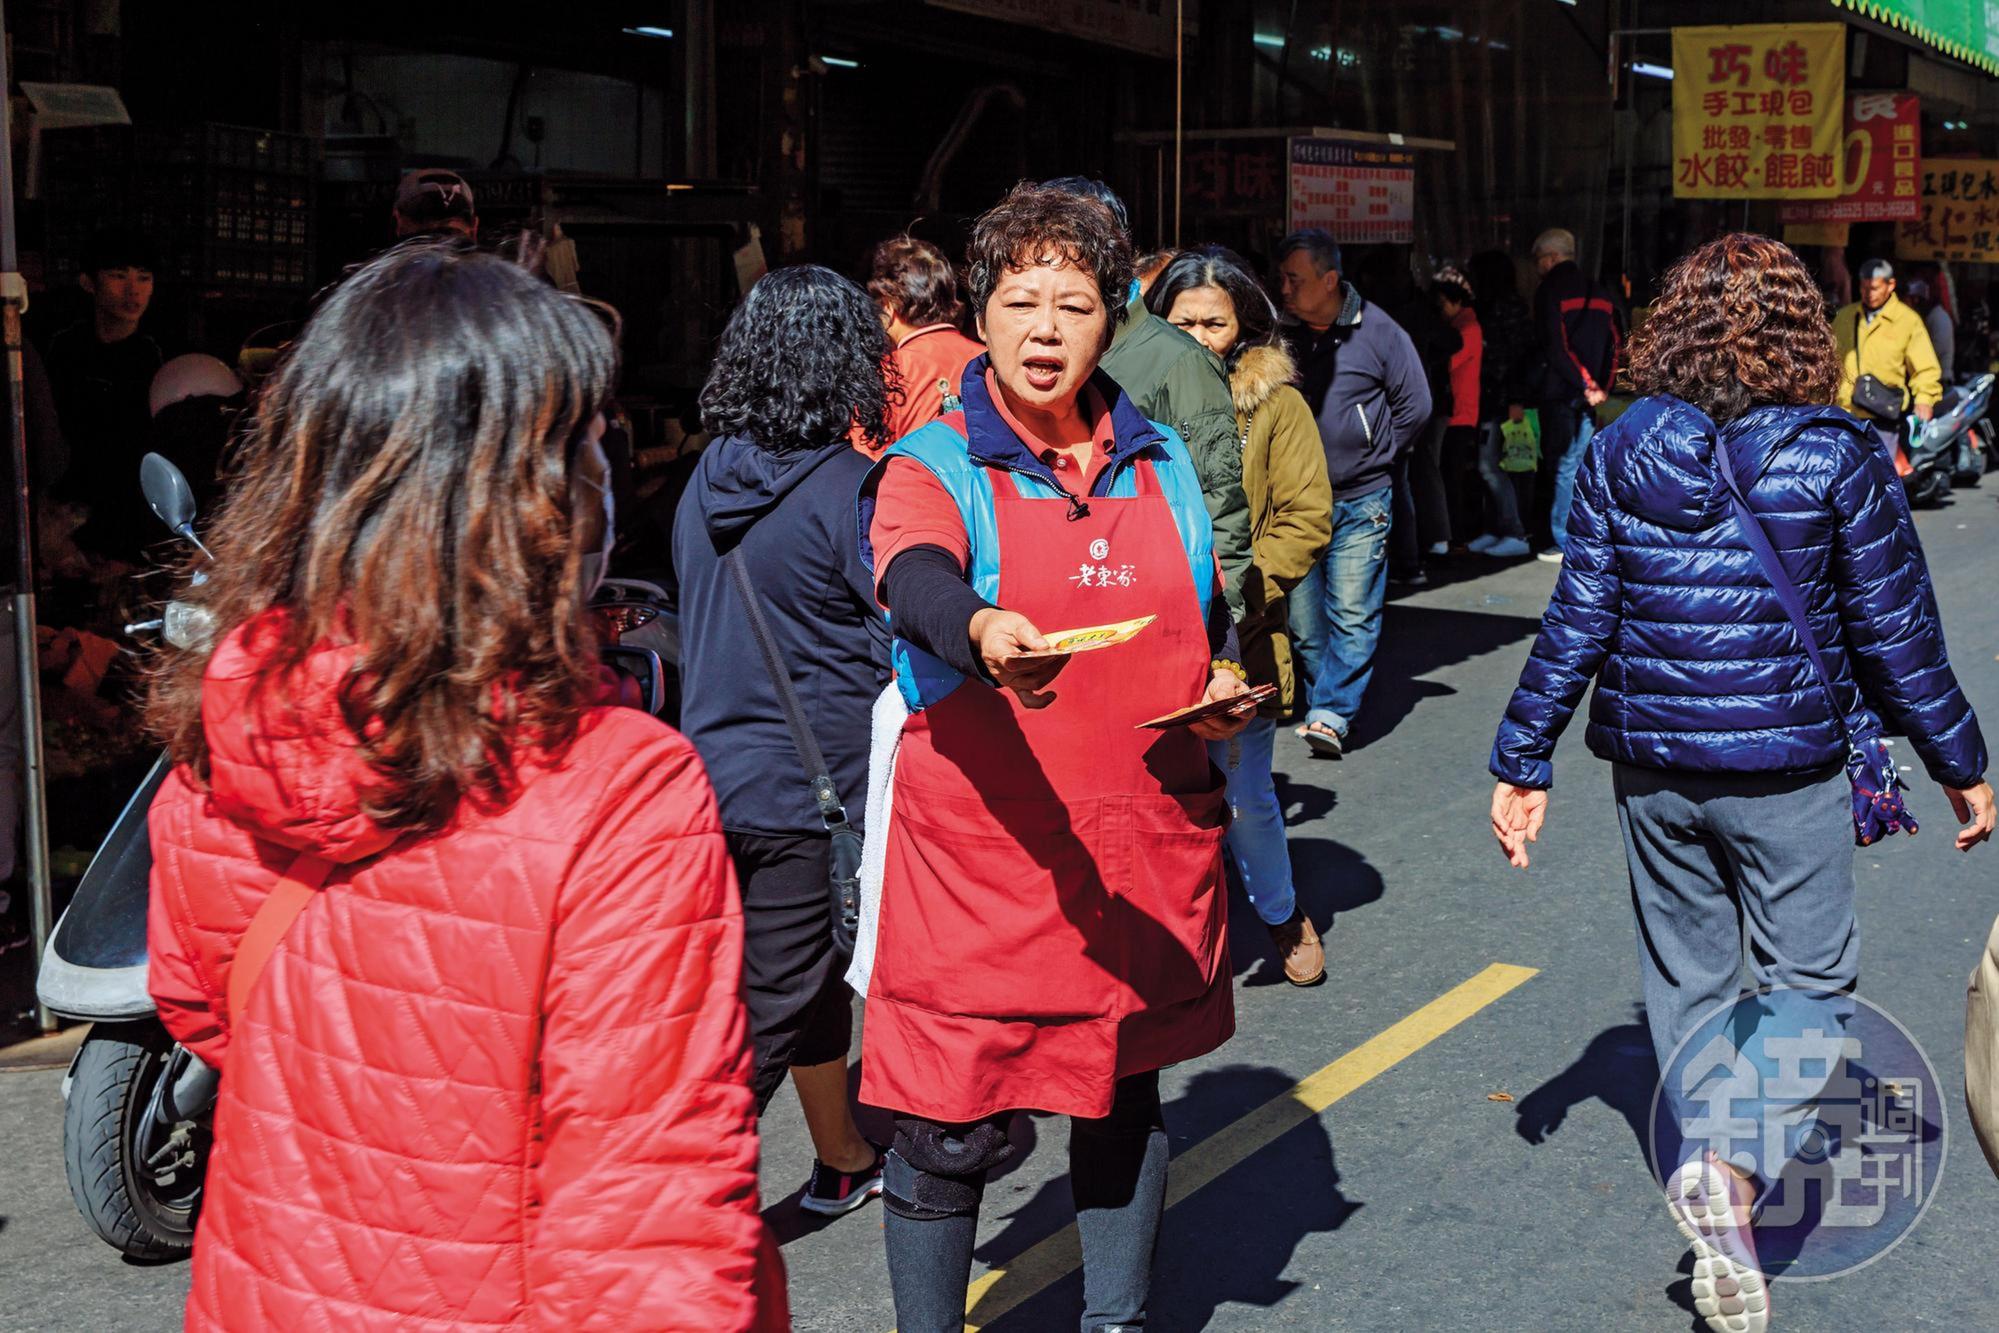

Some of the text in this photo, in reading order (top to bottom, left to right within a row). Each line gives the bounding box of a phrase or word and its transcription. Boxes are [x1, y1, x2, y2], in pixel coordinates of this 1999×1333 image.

[1708, 41, 1808, 86] 巧味
[1702, 89, 1813, 117] 手工現包
